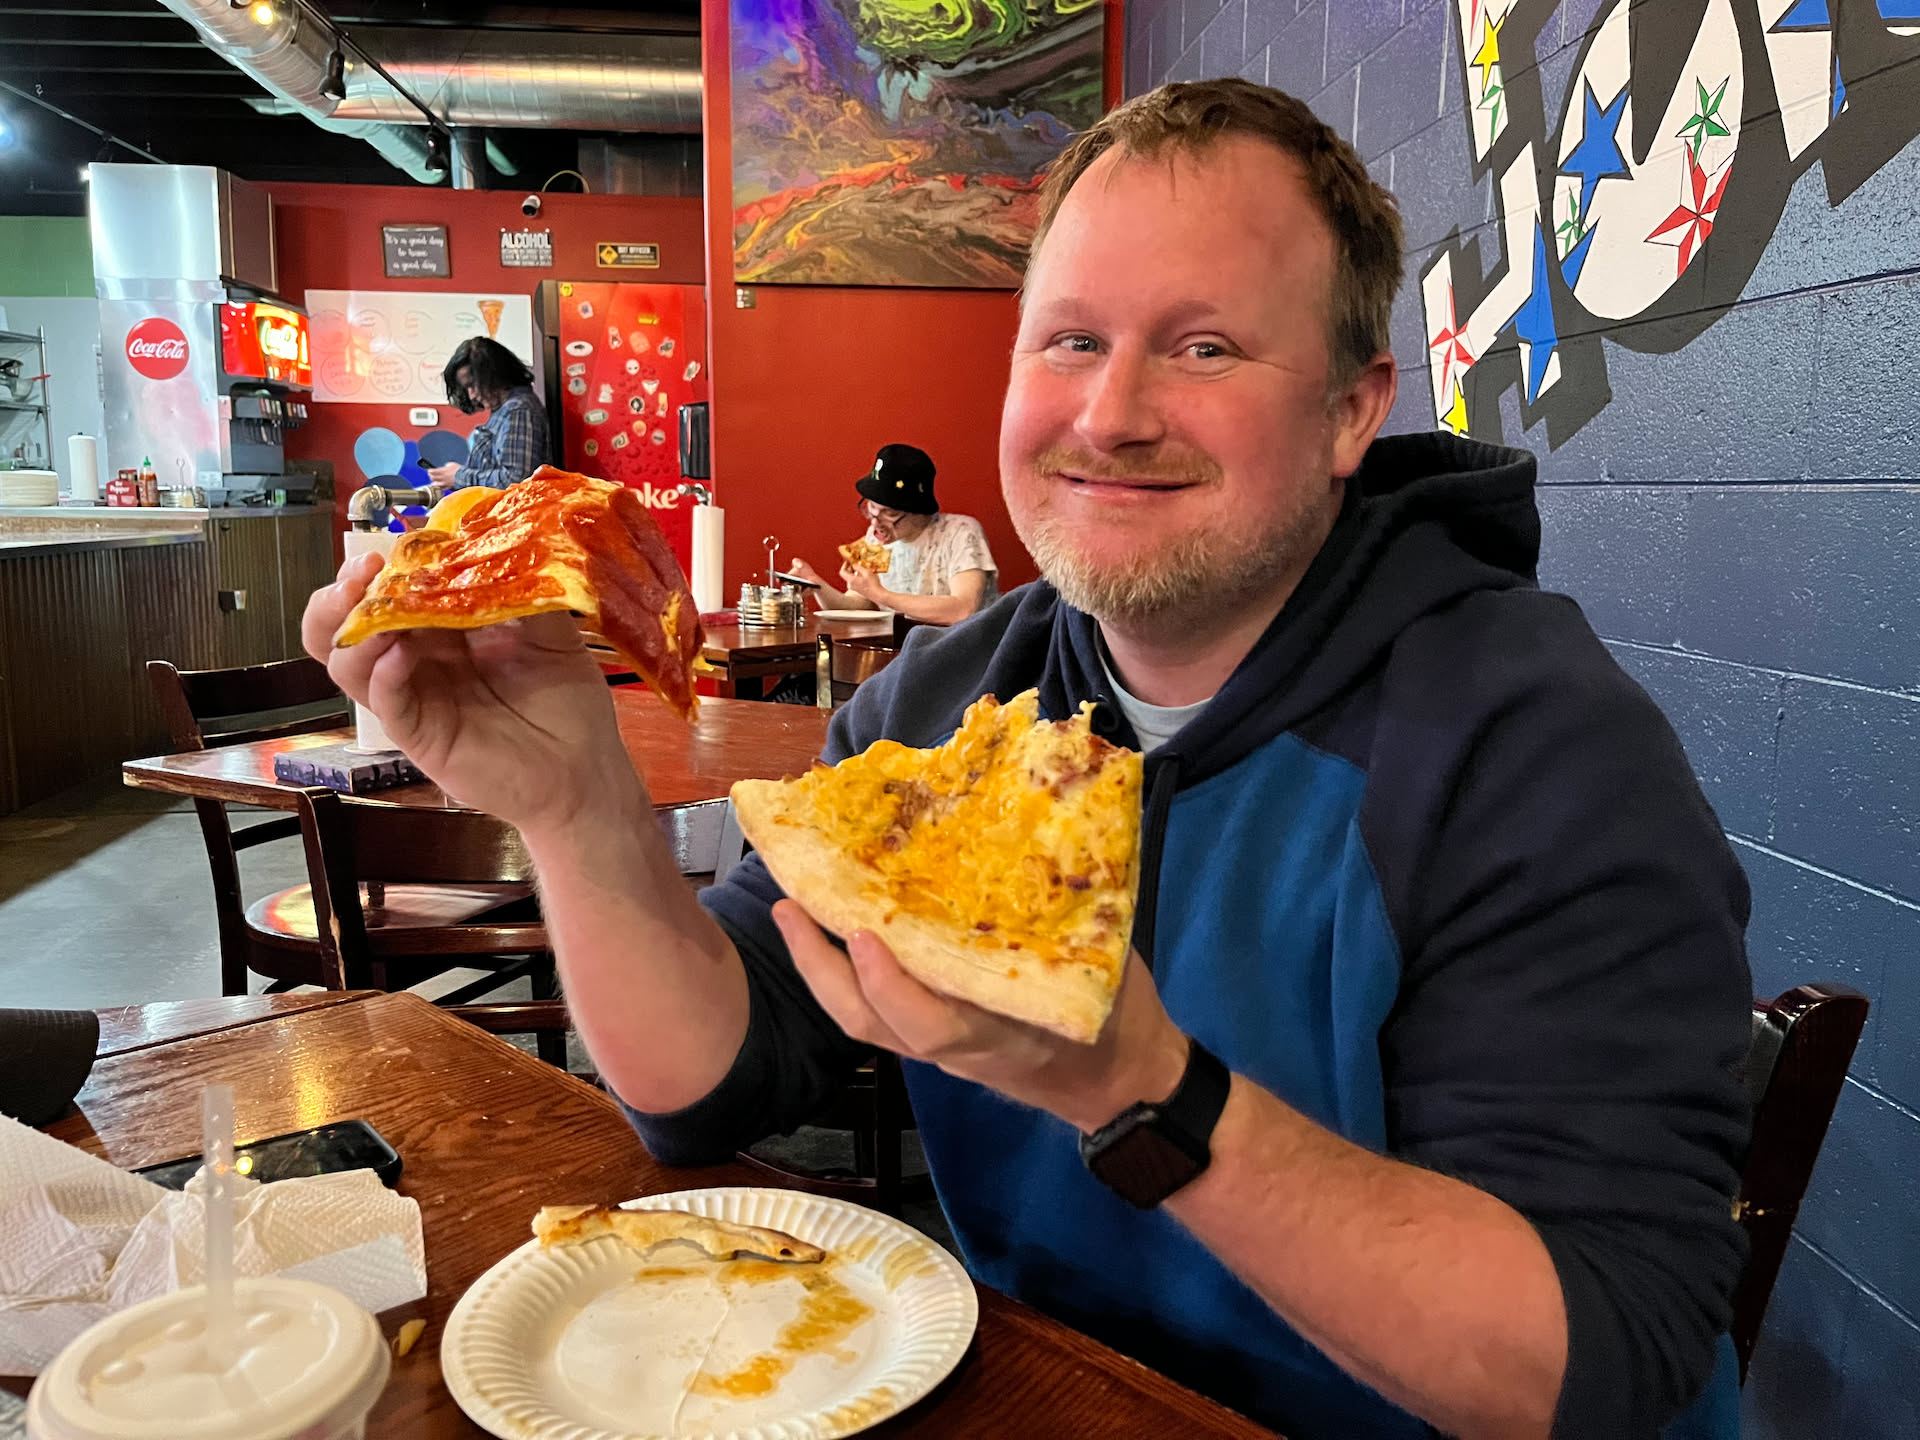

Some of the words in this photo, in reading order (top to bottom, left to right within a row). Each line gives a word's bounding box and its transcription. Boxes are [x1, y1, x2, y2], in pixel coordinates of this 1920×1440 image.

[501, 232, 551, 249] ALCOHOL
[128, 338, 187, 360] Coca-Cola
[609, 481, 680, 510] oke
